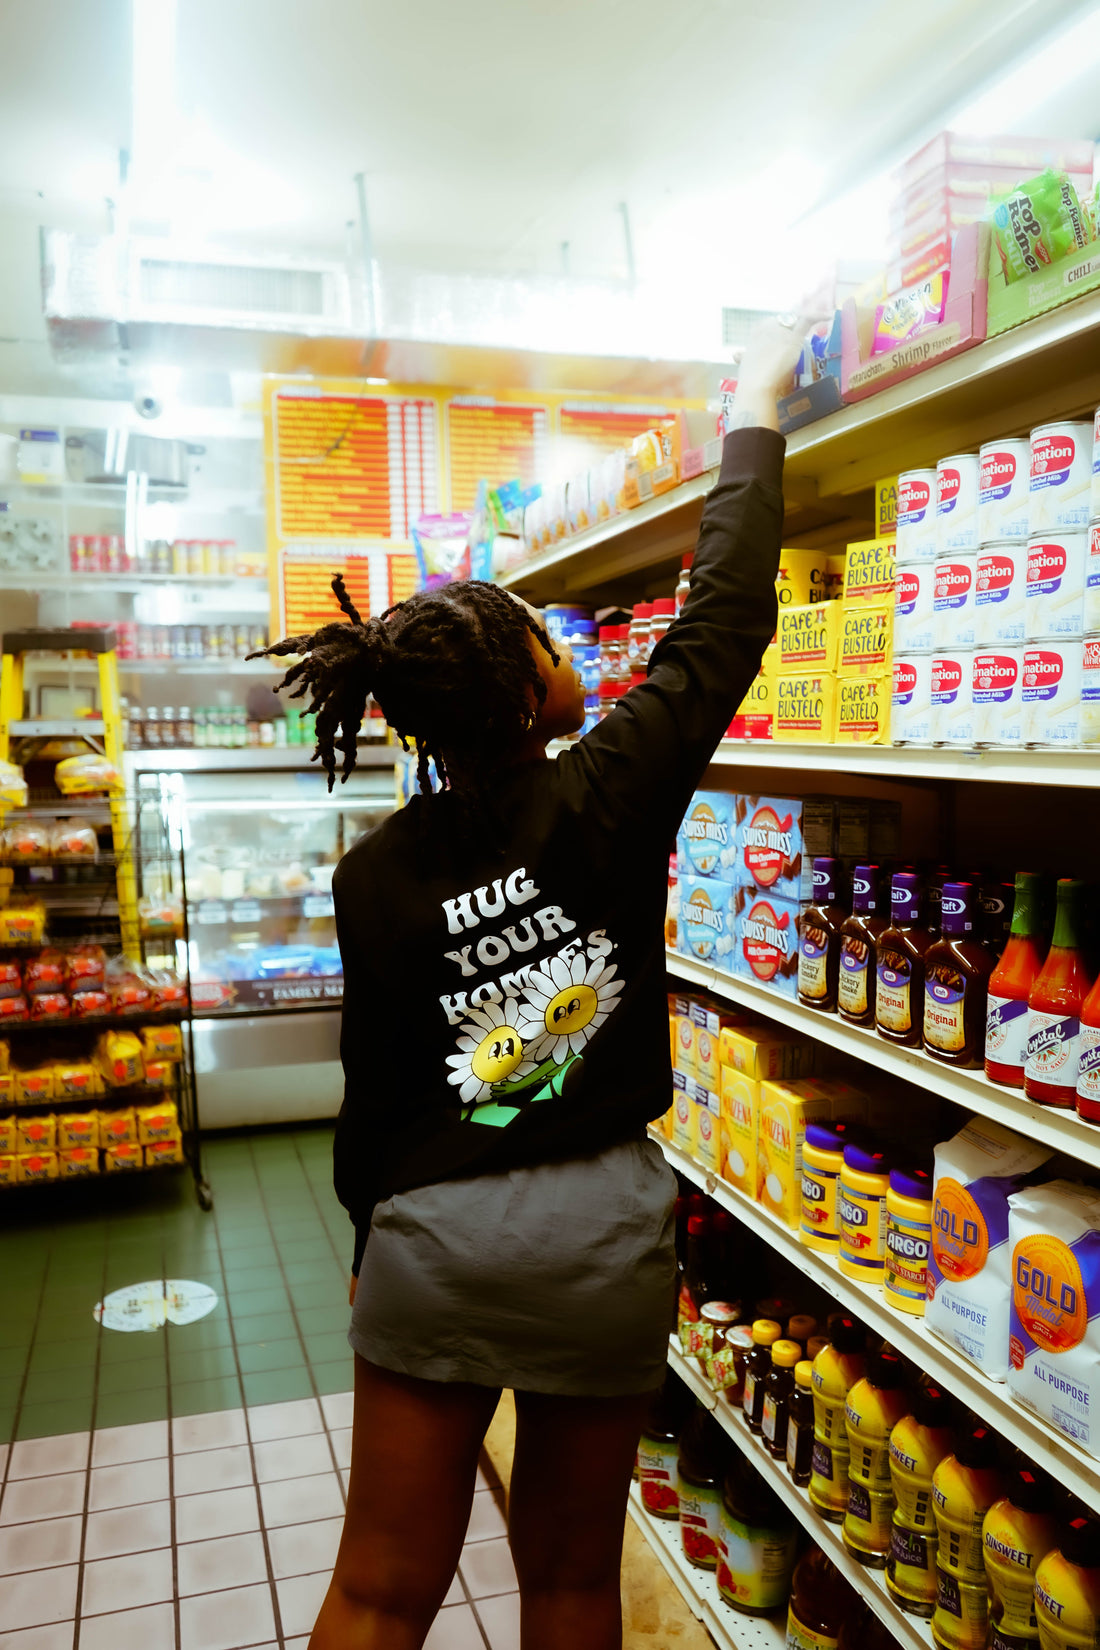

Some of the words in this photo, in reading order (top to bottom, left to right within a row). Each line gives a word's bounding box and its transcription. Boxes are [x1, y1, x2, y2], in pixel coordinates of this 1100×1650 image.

[1019, 196, 1042, 236] Top
[1061, 182, 1072, 206] Top
[1069, 207, 1084, 248] Ramen
[1067, 262, 1092, 283] CHILI
[892, 342, 930, 368] Shrimp
[782, 611, 813, 632] CAFE
[845, 617, 873, 636] CAFE
[781, 628, 827, 652] BUSTELO
[843, 633, 886, 654] BUSTELO
[779, 680, 809, 698] CAFE
[841, 685, 865, 702] CAFE
[778, 699, 824, 718] BUSTELO
[840, 701, 879, 721] BUSTELO
[441, 867, 541, 935] HUG
[444, 905, 577, 977] YOUR
[878, 992, 905, 1010] Original
[927, 1008, 957, 1028] Original
[1035, 1063, 1048, 1071] HOT
[1051, 1052, 1067, 1069] SAUCE
[762, 1112, 791, 1151] MAIZENA
[935, 1198, 978, 1246] GOLD
[888, 1233, 927, 1258] ARGO
[900, 1266, 925, 1281] STARCH
[1017, 1255, 1076, 1314] GOLD
[941, 1294, 951, 1309] ALL
[952, 1301, 987, 1327] PURPOSE
[1025, 1295, 1064, 1326] Medal
[1033, 1324, 1053, 1339] QUALITY
[1034, 1365, 1047, 1382] ALL
[1048, 1373, 1090, 1406] PURPOSE
[1070, 1398, 1090, 1416] FLOUR
[985, 1532, 1034, 1568] SUNSWEET
